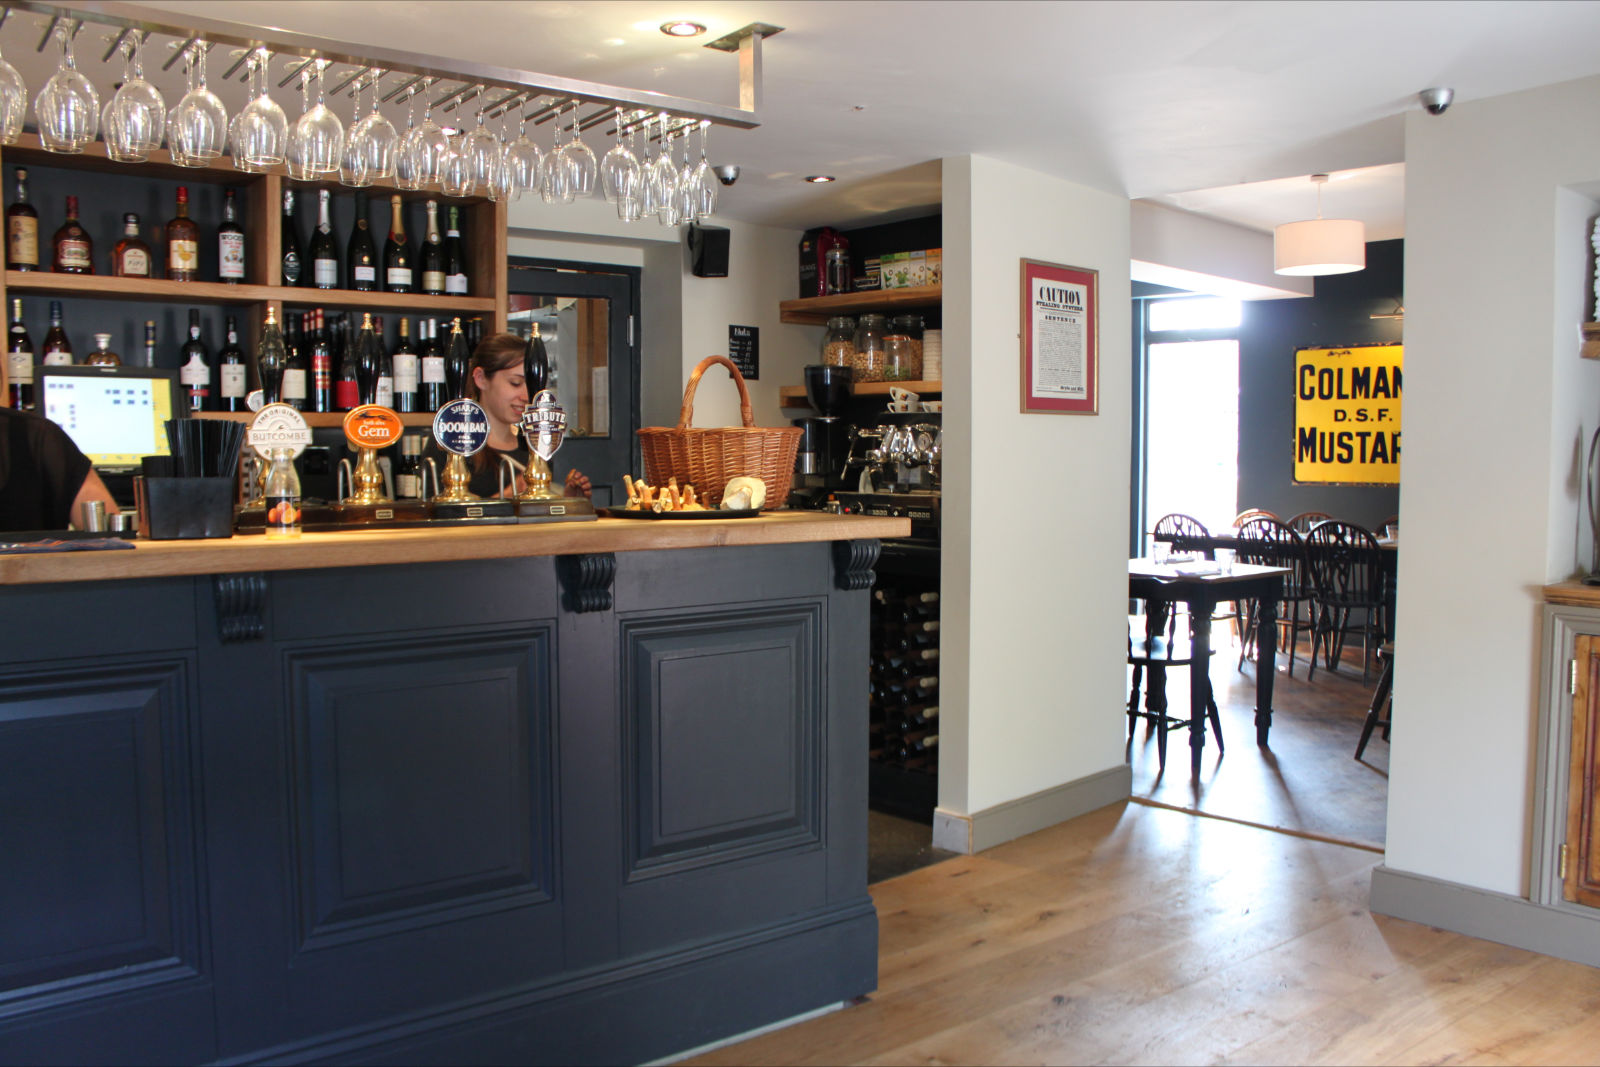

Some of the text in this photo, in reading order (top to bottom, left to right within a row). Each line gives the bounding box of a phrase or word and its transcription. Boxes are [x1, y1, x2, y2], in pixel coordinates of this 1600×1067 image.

[1039, 286, 1081, 305] CAUTION
[450, 404, 479, 414] SHARP'S
[1334, 408, 1393, 422] D.S.F.
[524, 411, 566, 423] TRIBUTE
[358, 424, 390, 437] Gem
[439, 421, 486, 433] DOOM BAR
[252, 432, 306, 441] BUTCOMBE
